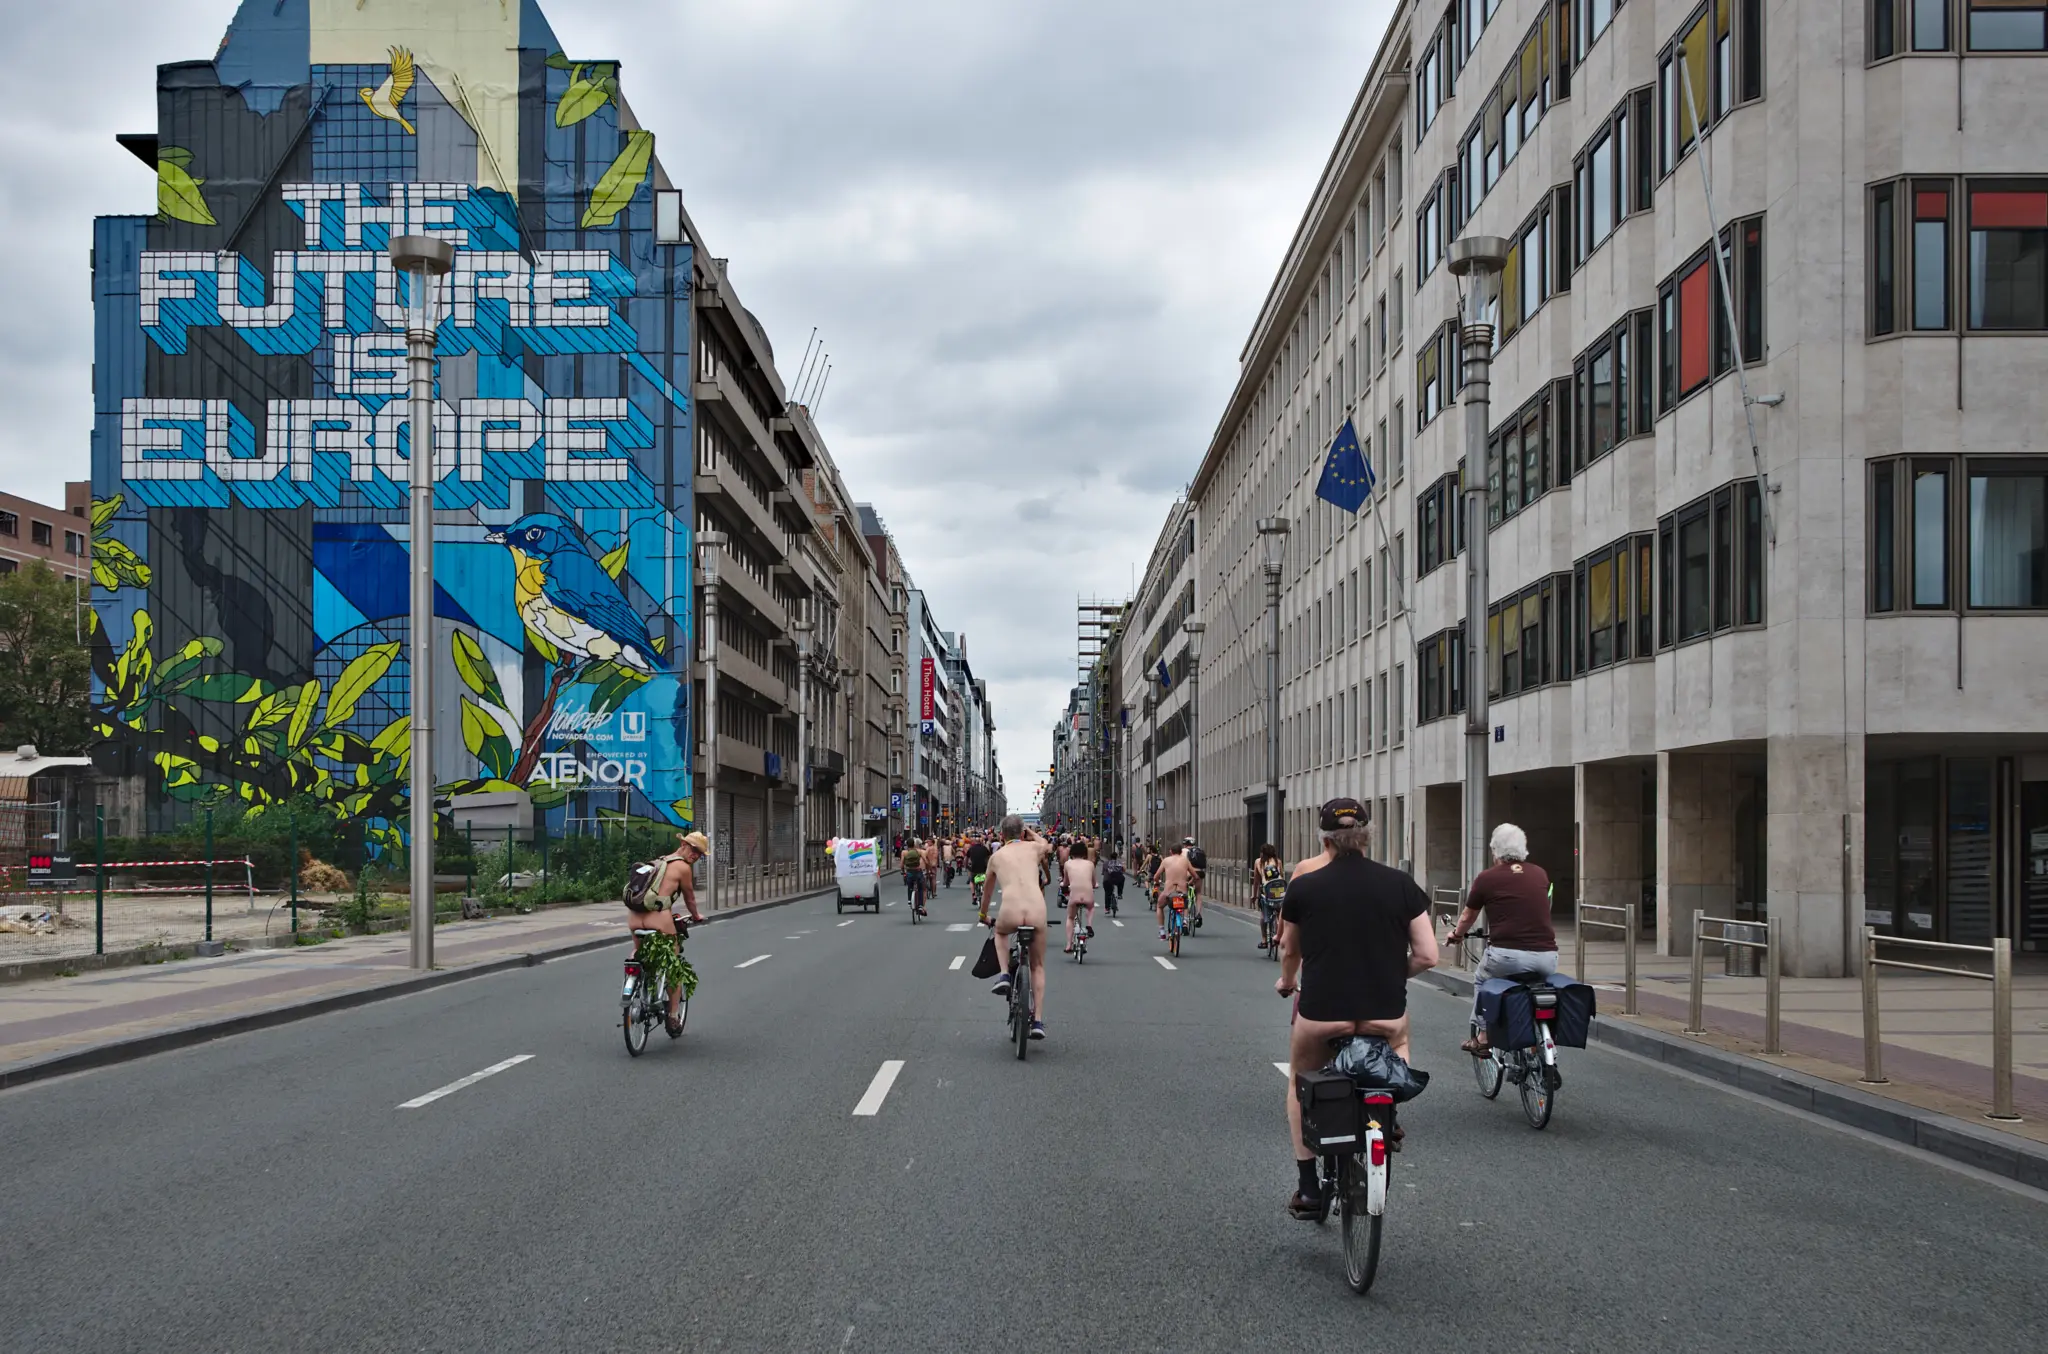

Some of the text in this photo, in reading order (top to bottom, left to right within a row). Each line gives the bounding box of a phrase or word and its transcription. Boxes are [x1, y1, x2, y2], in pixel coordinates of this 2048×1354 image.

[281, 183, 469, 246] THE
[140, 250, 610, 328] FUTURE
[334, 332, 412, 395] IS
[122, 397, 628, 482] EUROPE
[923, 666, 932, 716] Thon Hotels
[552, 733, 614, 741] NOVADEAD.COM
[528, 752, 647, 790] ATENOR
